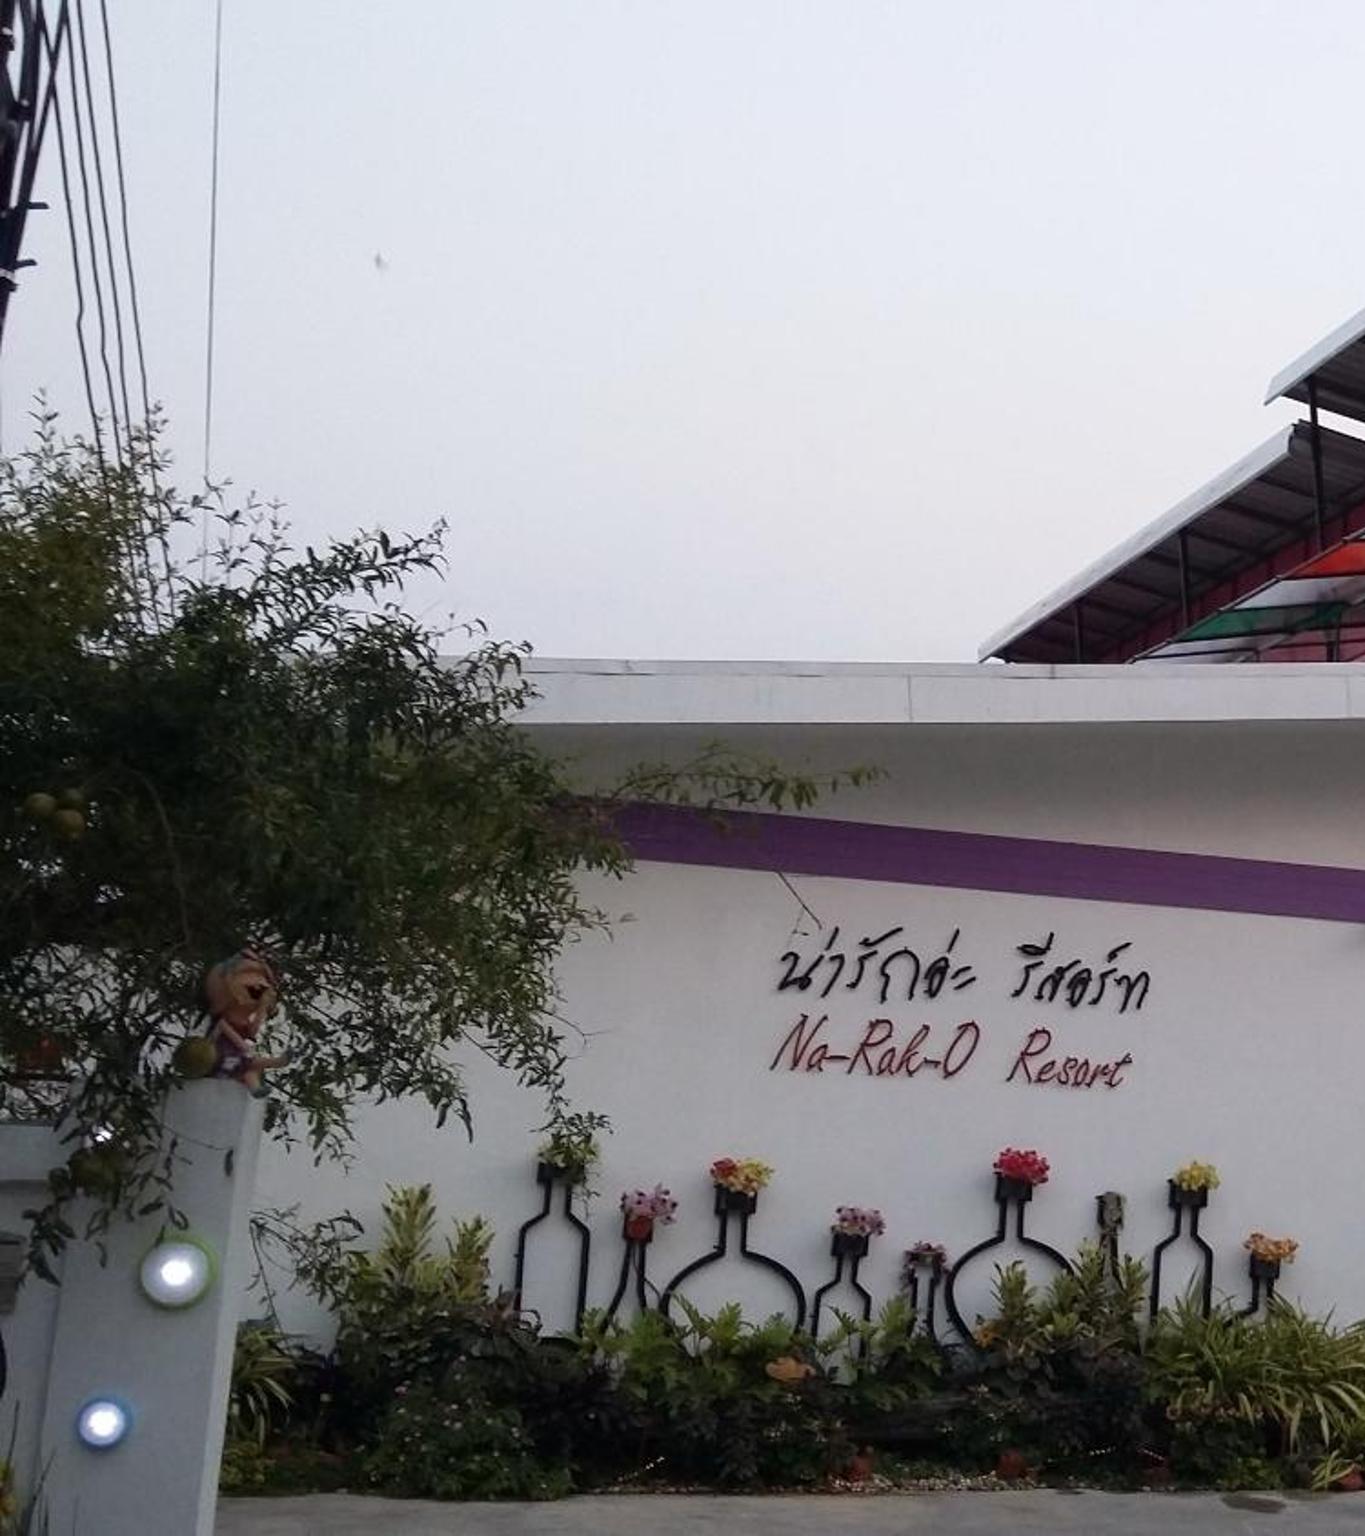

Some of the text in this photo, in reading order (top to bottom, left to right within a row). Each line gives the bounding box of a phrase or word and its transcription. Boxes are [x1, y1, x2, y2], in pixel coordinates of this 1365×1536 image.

[1010, 932, 1150, 1014] รีสอร์ท
[770, 1013, 1133, 1089] Na-Rak-O Resort
